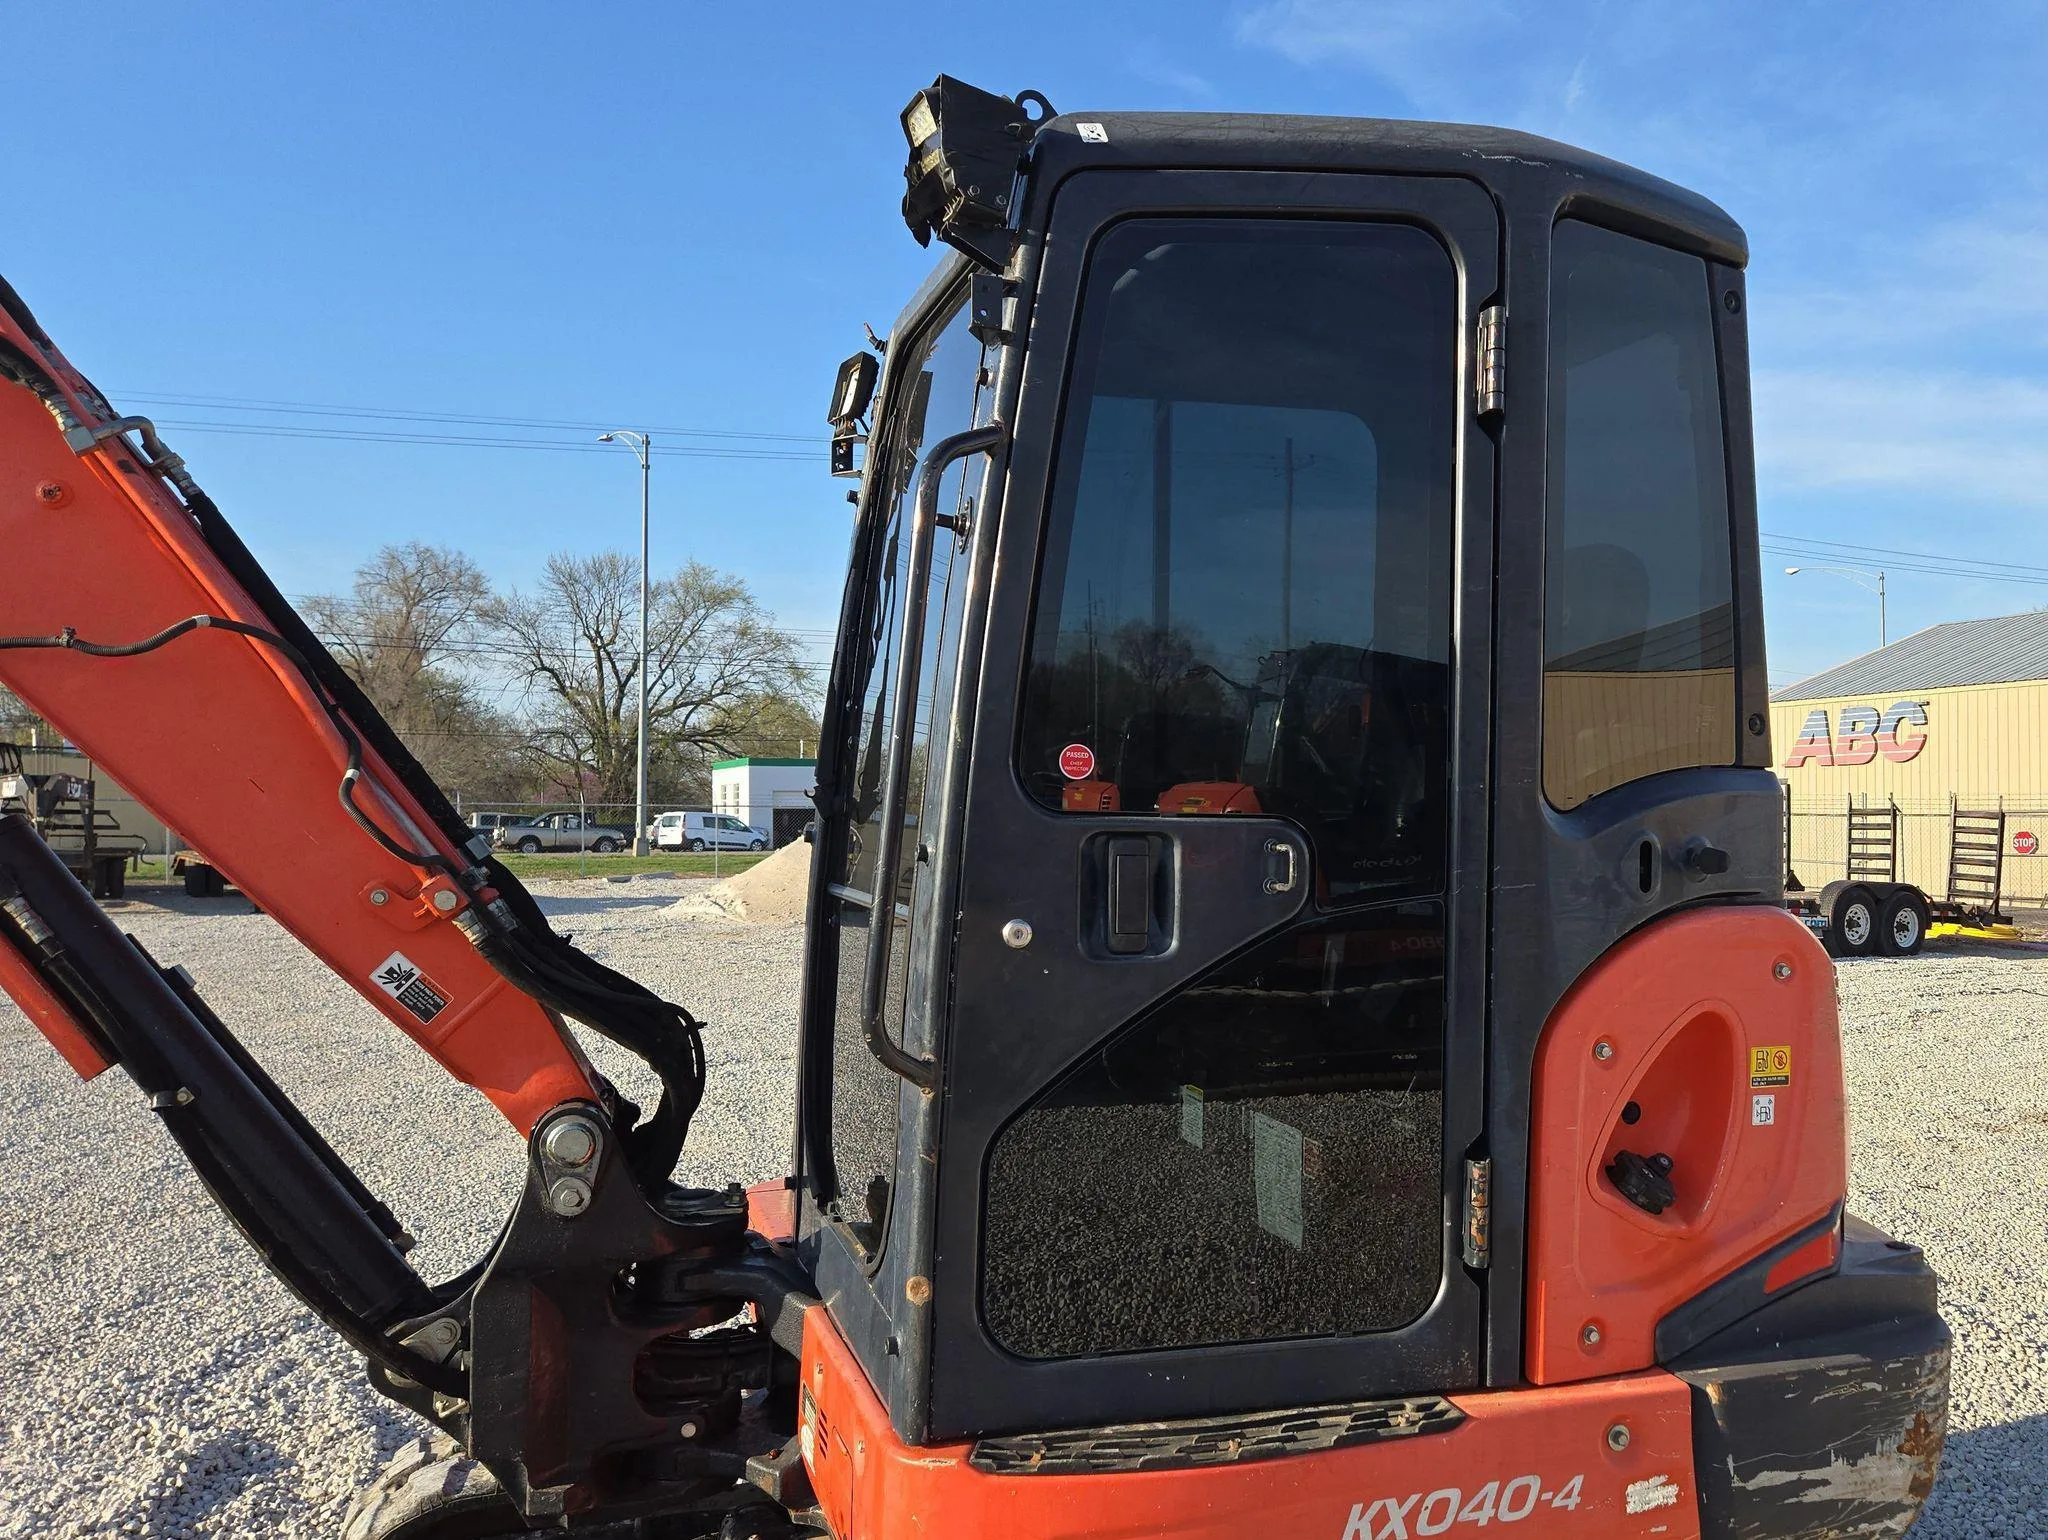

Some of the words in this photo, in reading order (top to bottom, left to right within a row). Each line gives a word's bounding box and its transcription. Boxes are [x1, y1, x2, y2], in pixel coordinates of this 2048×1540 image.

[1783, 701, 1930, 768] ABC
[1066, 751, 1089, 759] PASSED
[2013, 837, 2034, 848] STOP
[1341, 1474, 1585, 1540] KX040-4
